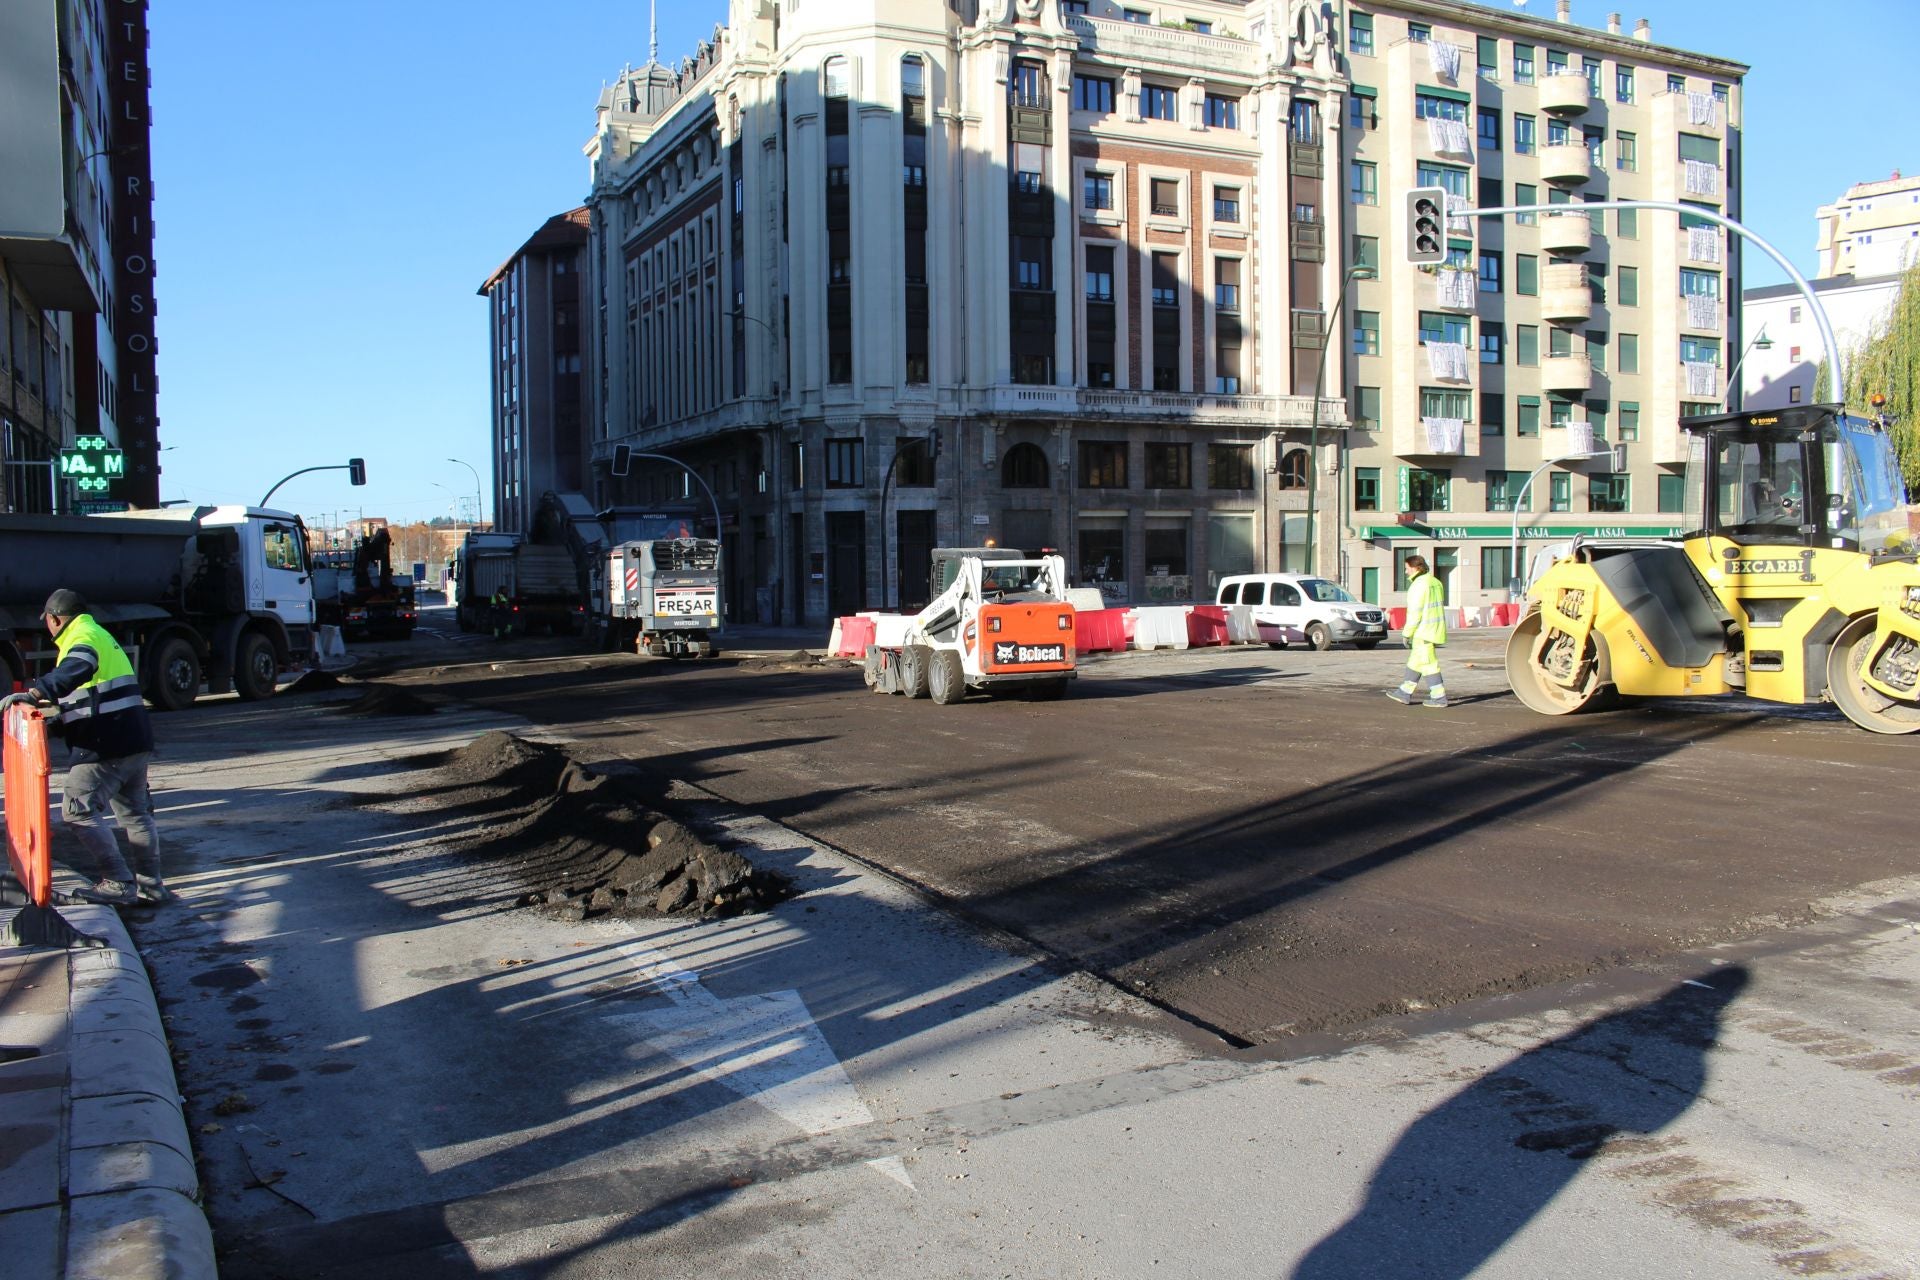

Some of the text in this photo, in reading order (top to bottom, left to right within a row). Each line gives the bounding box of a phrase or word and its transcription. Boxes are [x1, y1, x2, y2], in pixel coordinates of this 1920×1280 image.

[123, 0, 149, 393] TEL RIOSOL
[1438, 527, 1468, 539] ASAJA
[1521, 527, 1549, 538] ASAJA
[1600, 527, 1626, 538] ASAJA
[1731, 560, 1804, 574] EXCARBI
[658, 599, 712, 612] FRESAR
[1018, 646, 1062, 662] Bobcat
